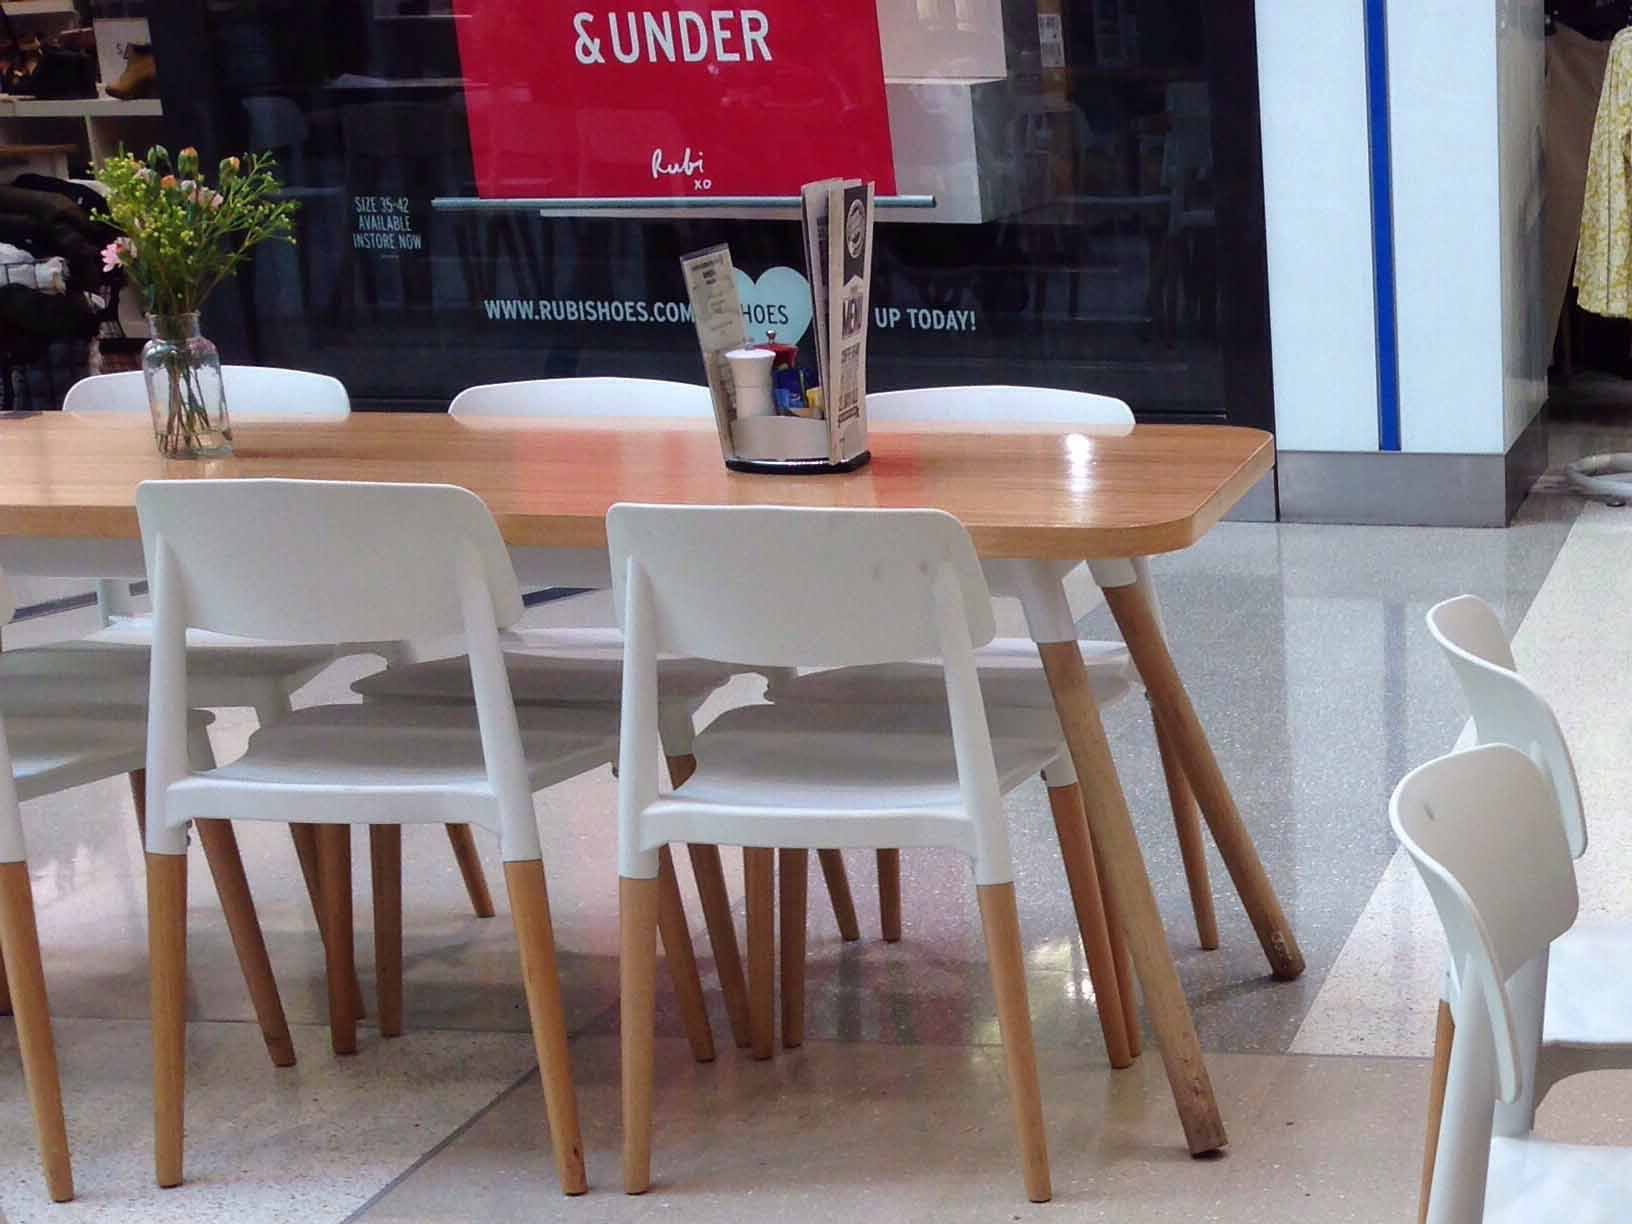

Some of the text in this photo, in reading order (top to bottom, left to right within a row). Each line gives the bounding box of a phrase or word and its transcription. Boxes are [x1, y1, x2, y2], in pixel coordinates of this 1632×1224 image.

[651, 147, 705, 179] Rubi
[354, 196, 409, 214] SIZE 35-42
[358, 215, 412, 232] AVAILABLE
[352, 232, 422, 250] INSTORE NOW
[484, 299, 697, 323] WWW.RUBISHOES.COM
[740, 303, 789, 325] HOES
[874, 307, 901, 328] UP
[907, 308, 977, 331] TODAY!
